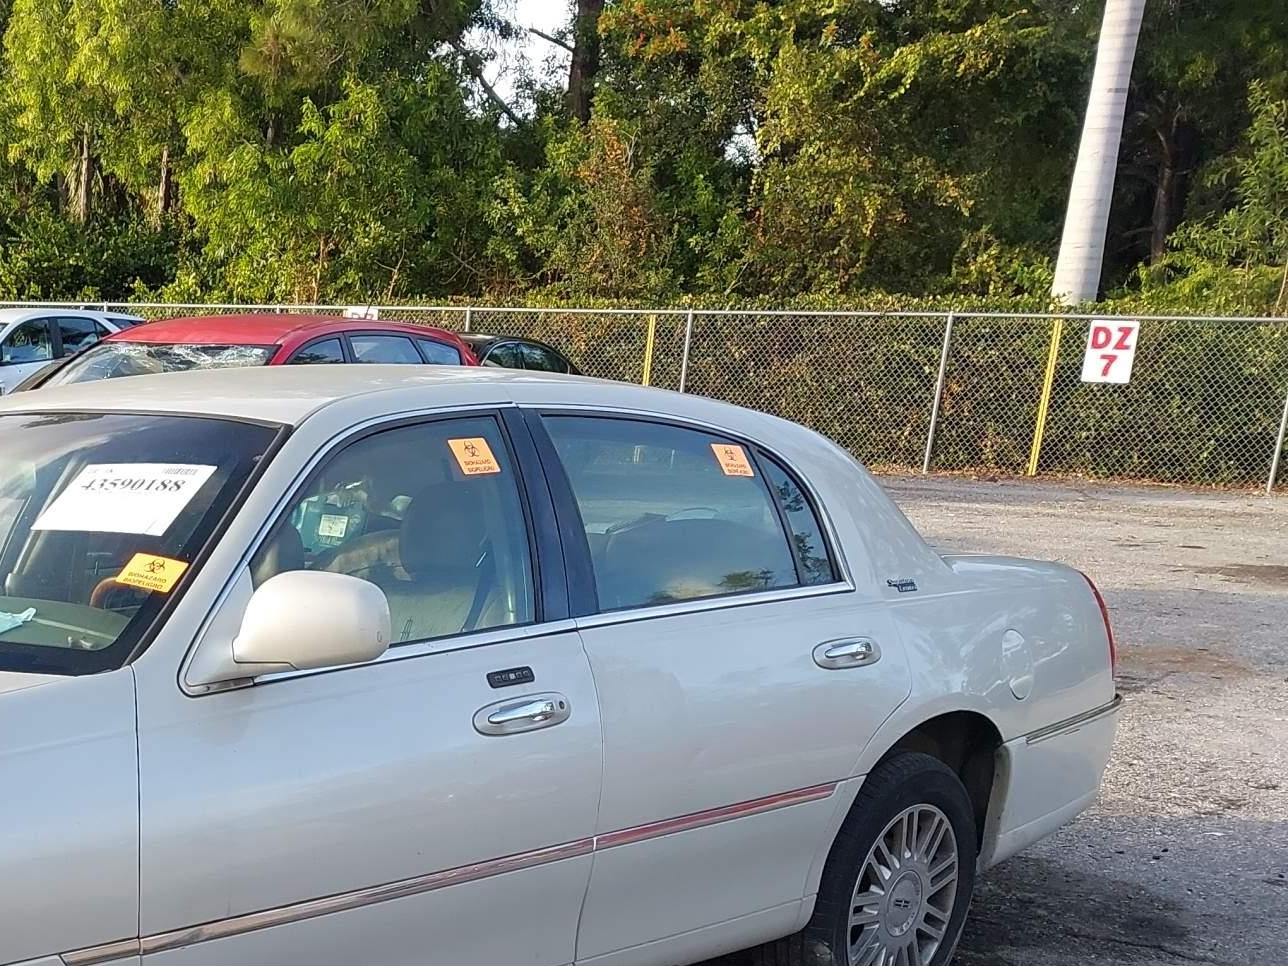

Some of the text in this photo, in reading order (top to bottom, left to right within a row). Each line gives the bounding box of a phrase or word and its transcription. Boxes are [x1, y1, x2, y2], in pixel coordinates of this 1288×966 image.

[1091, 326, 1134, 350] DZ
[1100, 354, 1118, 377] 7
[80, 478, 187, 492] 43590188
[128, 571, 167, 584] BIOHAZARD
